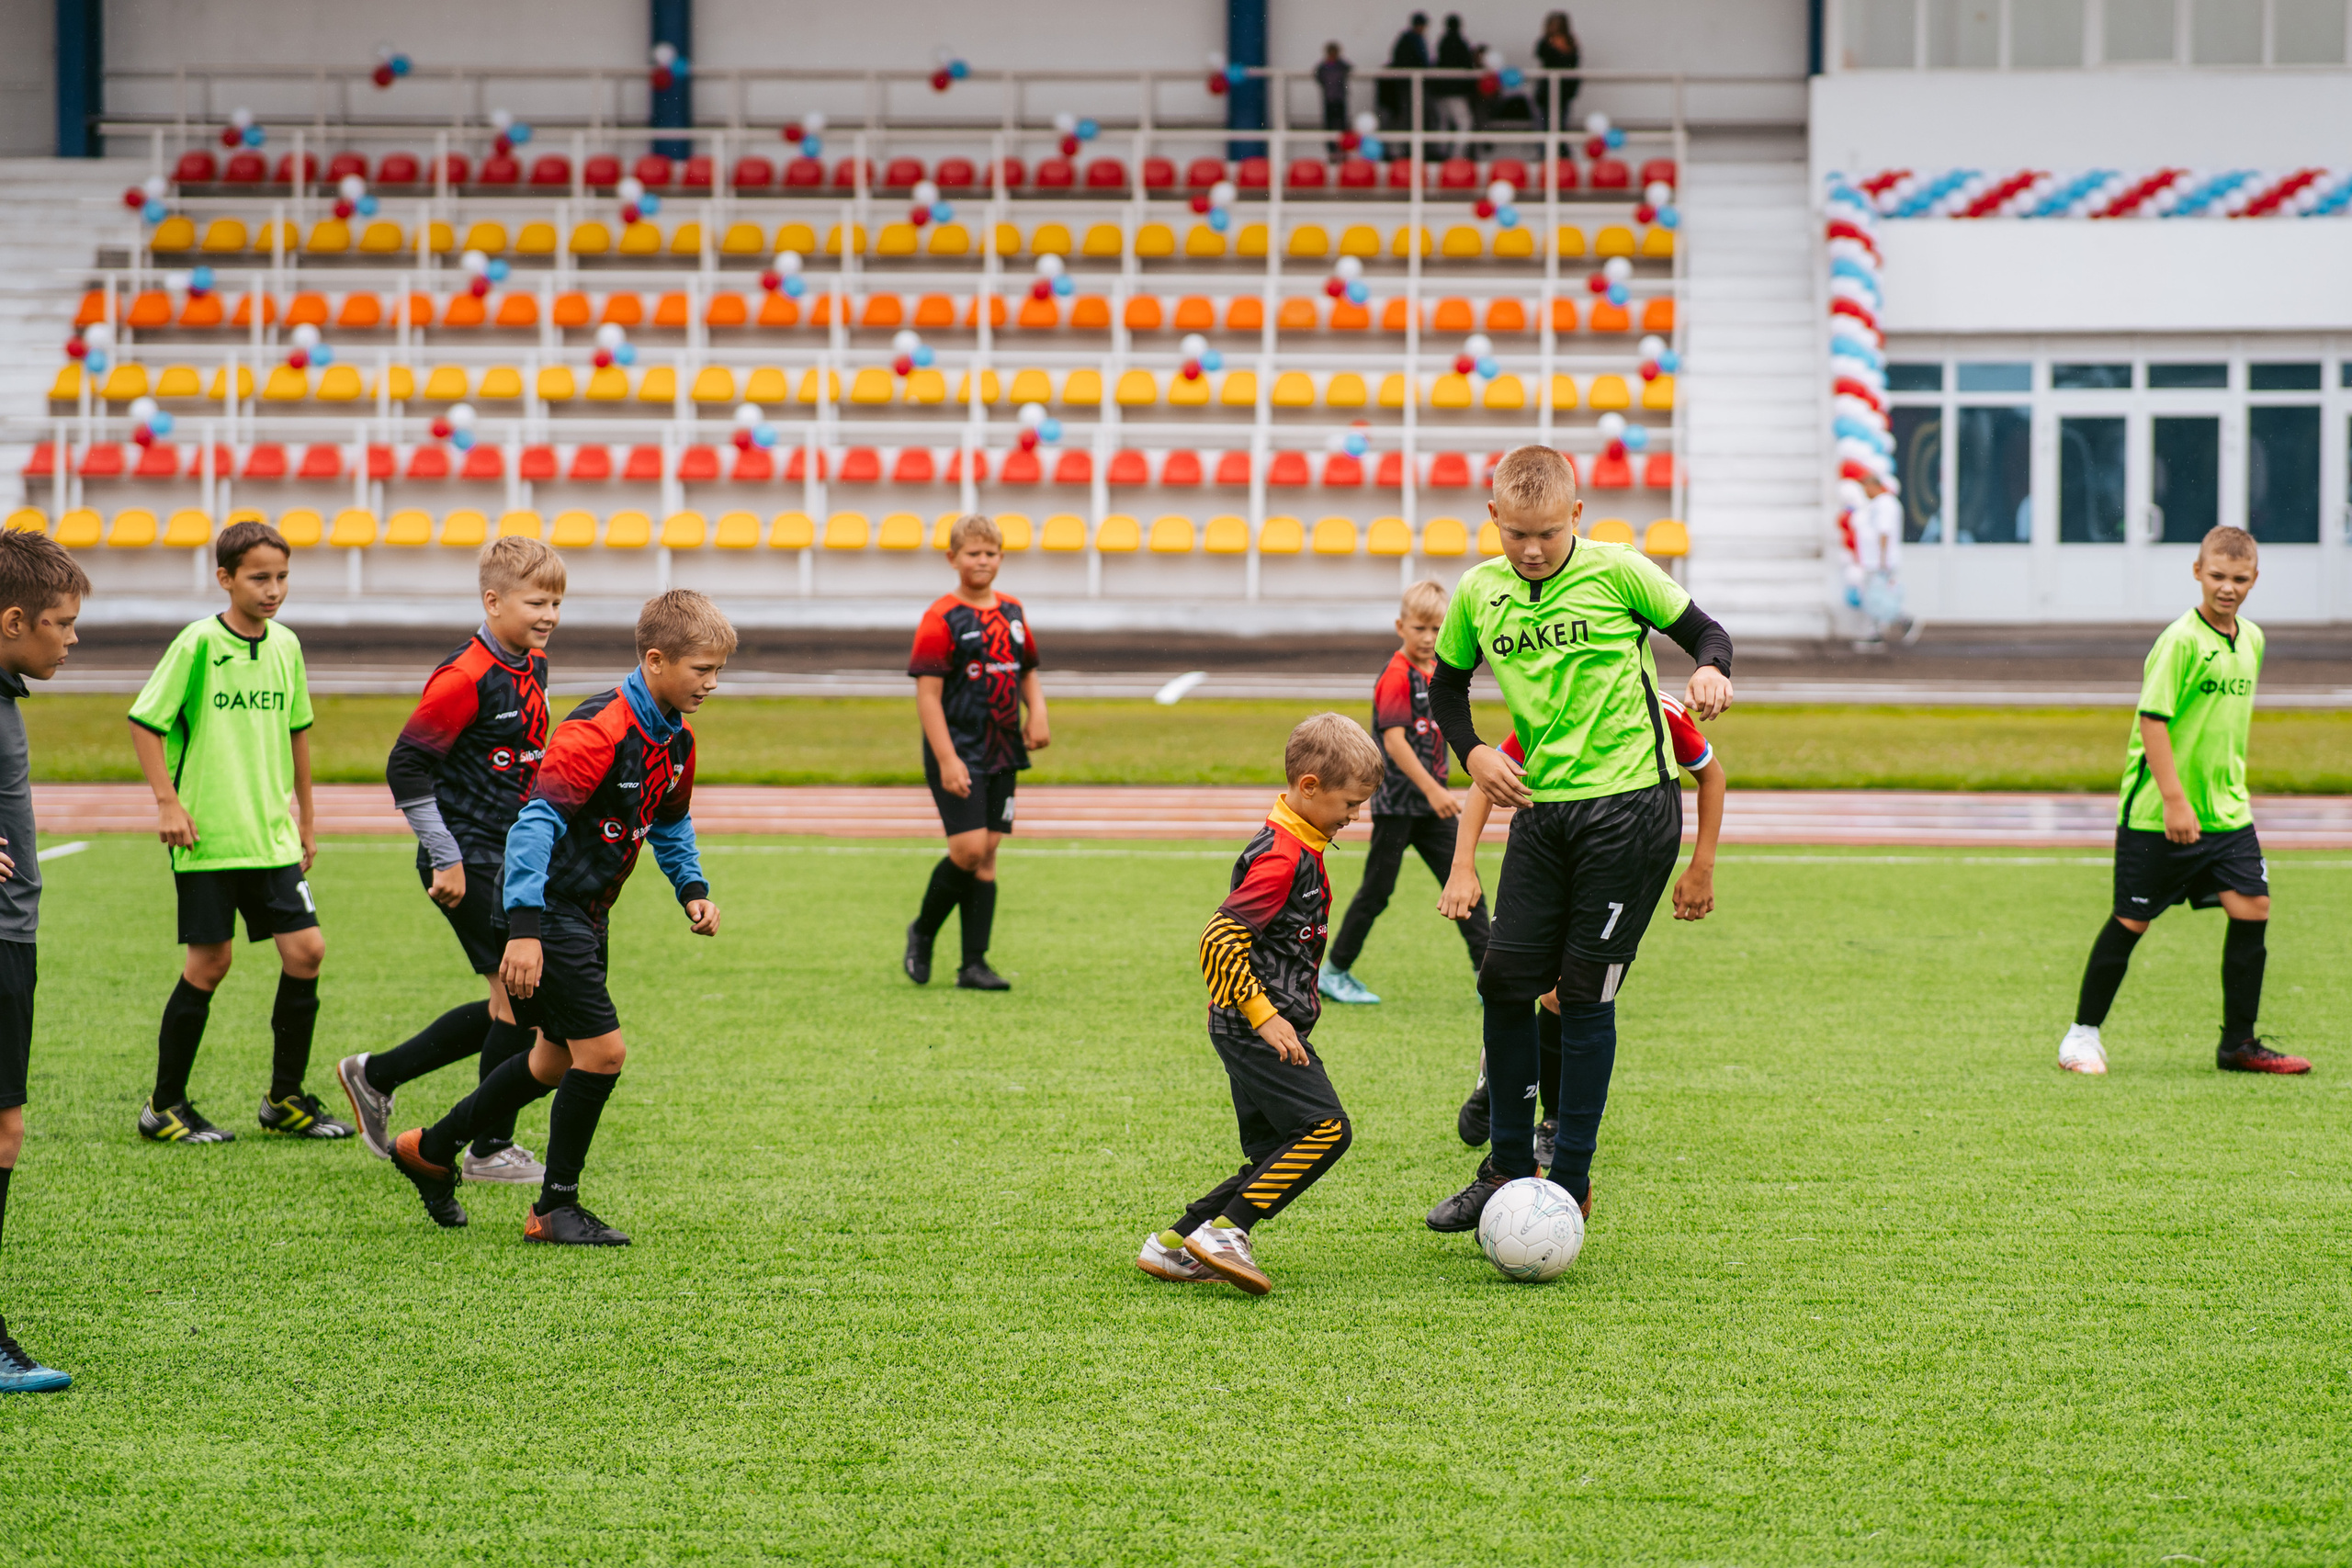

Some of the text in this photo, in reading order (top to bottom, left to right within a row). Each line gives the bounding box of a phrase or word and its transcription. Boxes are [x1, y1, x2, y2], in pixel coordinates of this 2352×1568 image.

[1492, 620, 1589, 657] ФАКЕЛ
[214, 690, 284, 711] ФАКЕЛ
[2199, 678, 2251, 695] ФАКЕЛ
[1600, 901, 1624, 940] 7
